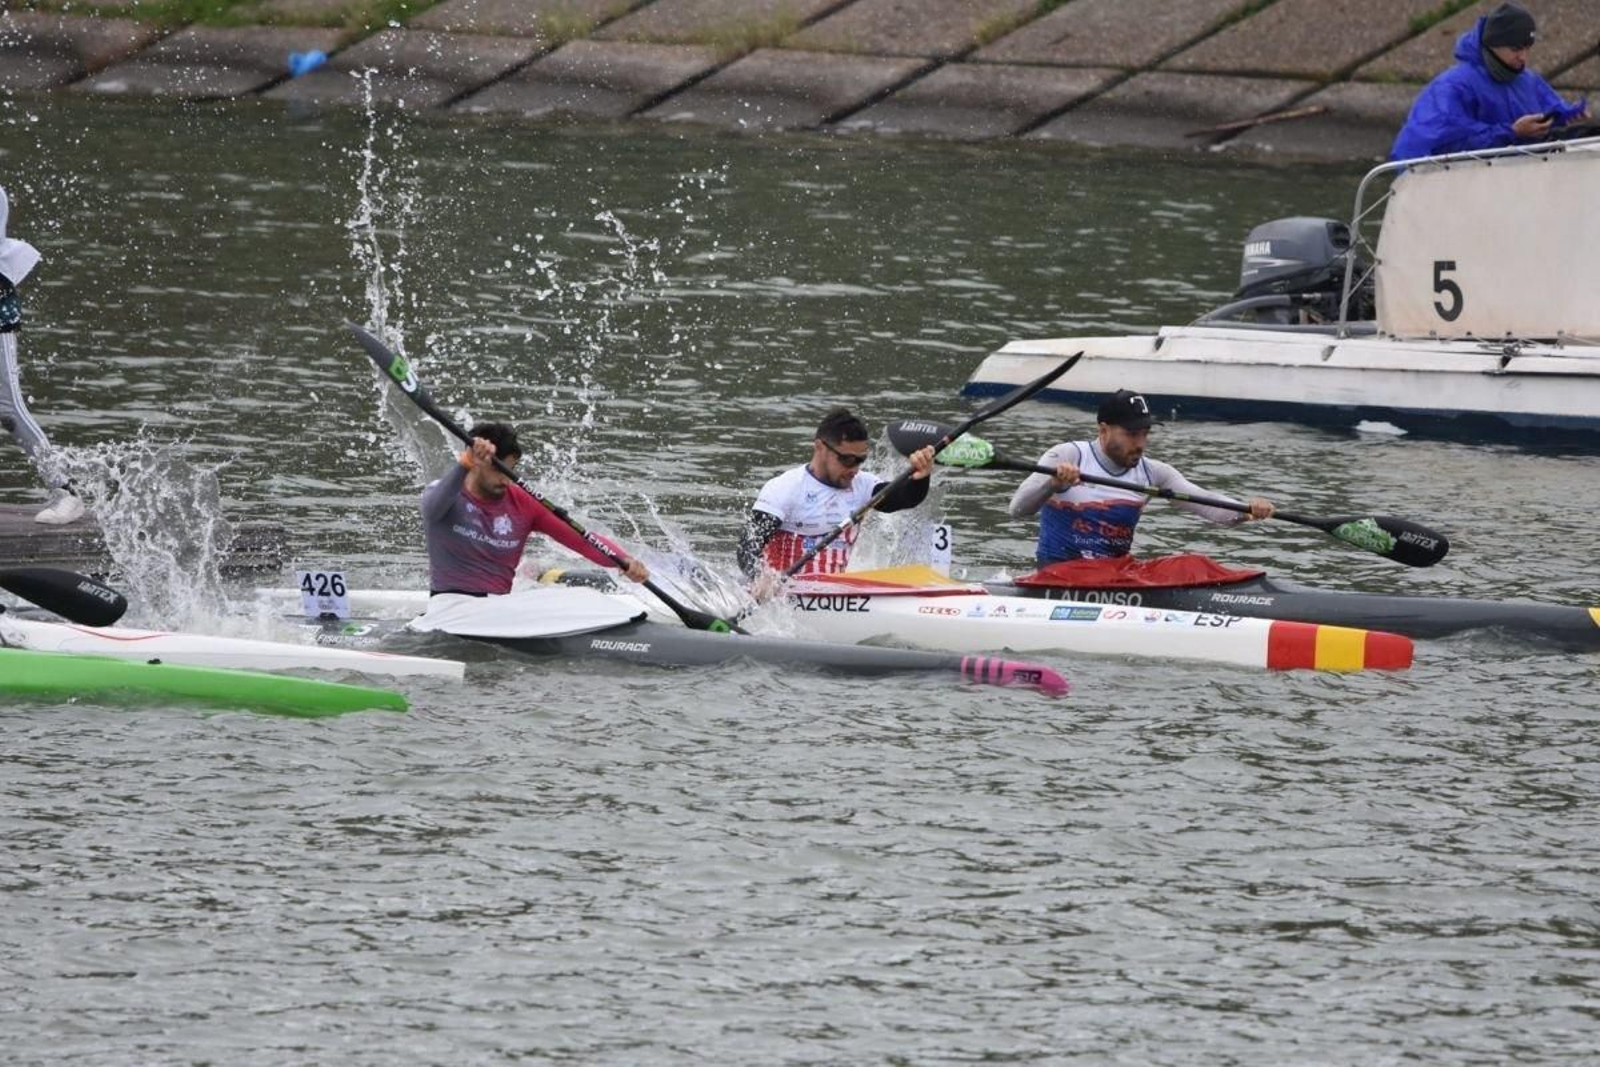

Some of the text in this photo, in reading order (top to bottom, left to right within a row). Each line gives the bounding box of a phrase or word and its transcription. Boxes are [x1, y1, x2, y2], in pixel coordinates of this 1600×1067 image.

[1433, 260, 1464, 322] 5
[301, 573, 346, 597] 426
[1211, 593, 1275, 606] ROURACE
[918, 606, 961, 616] NELO
[590, 639, 651, 653] ROURACE
